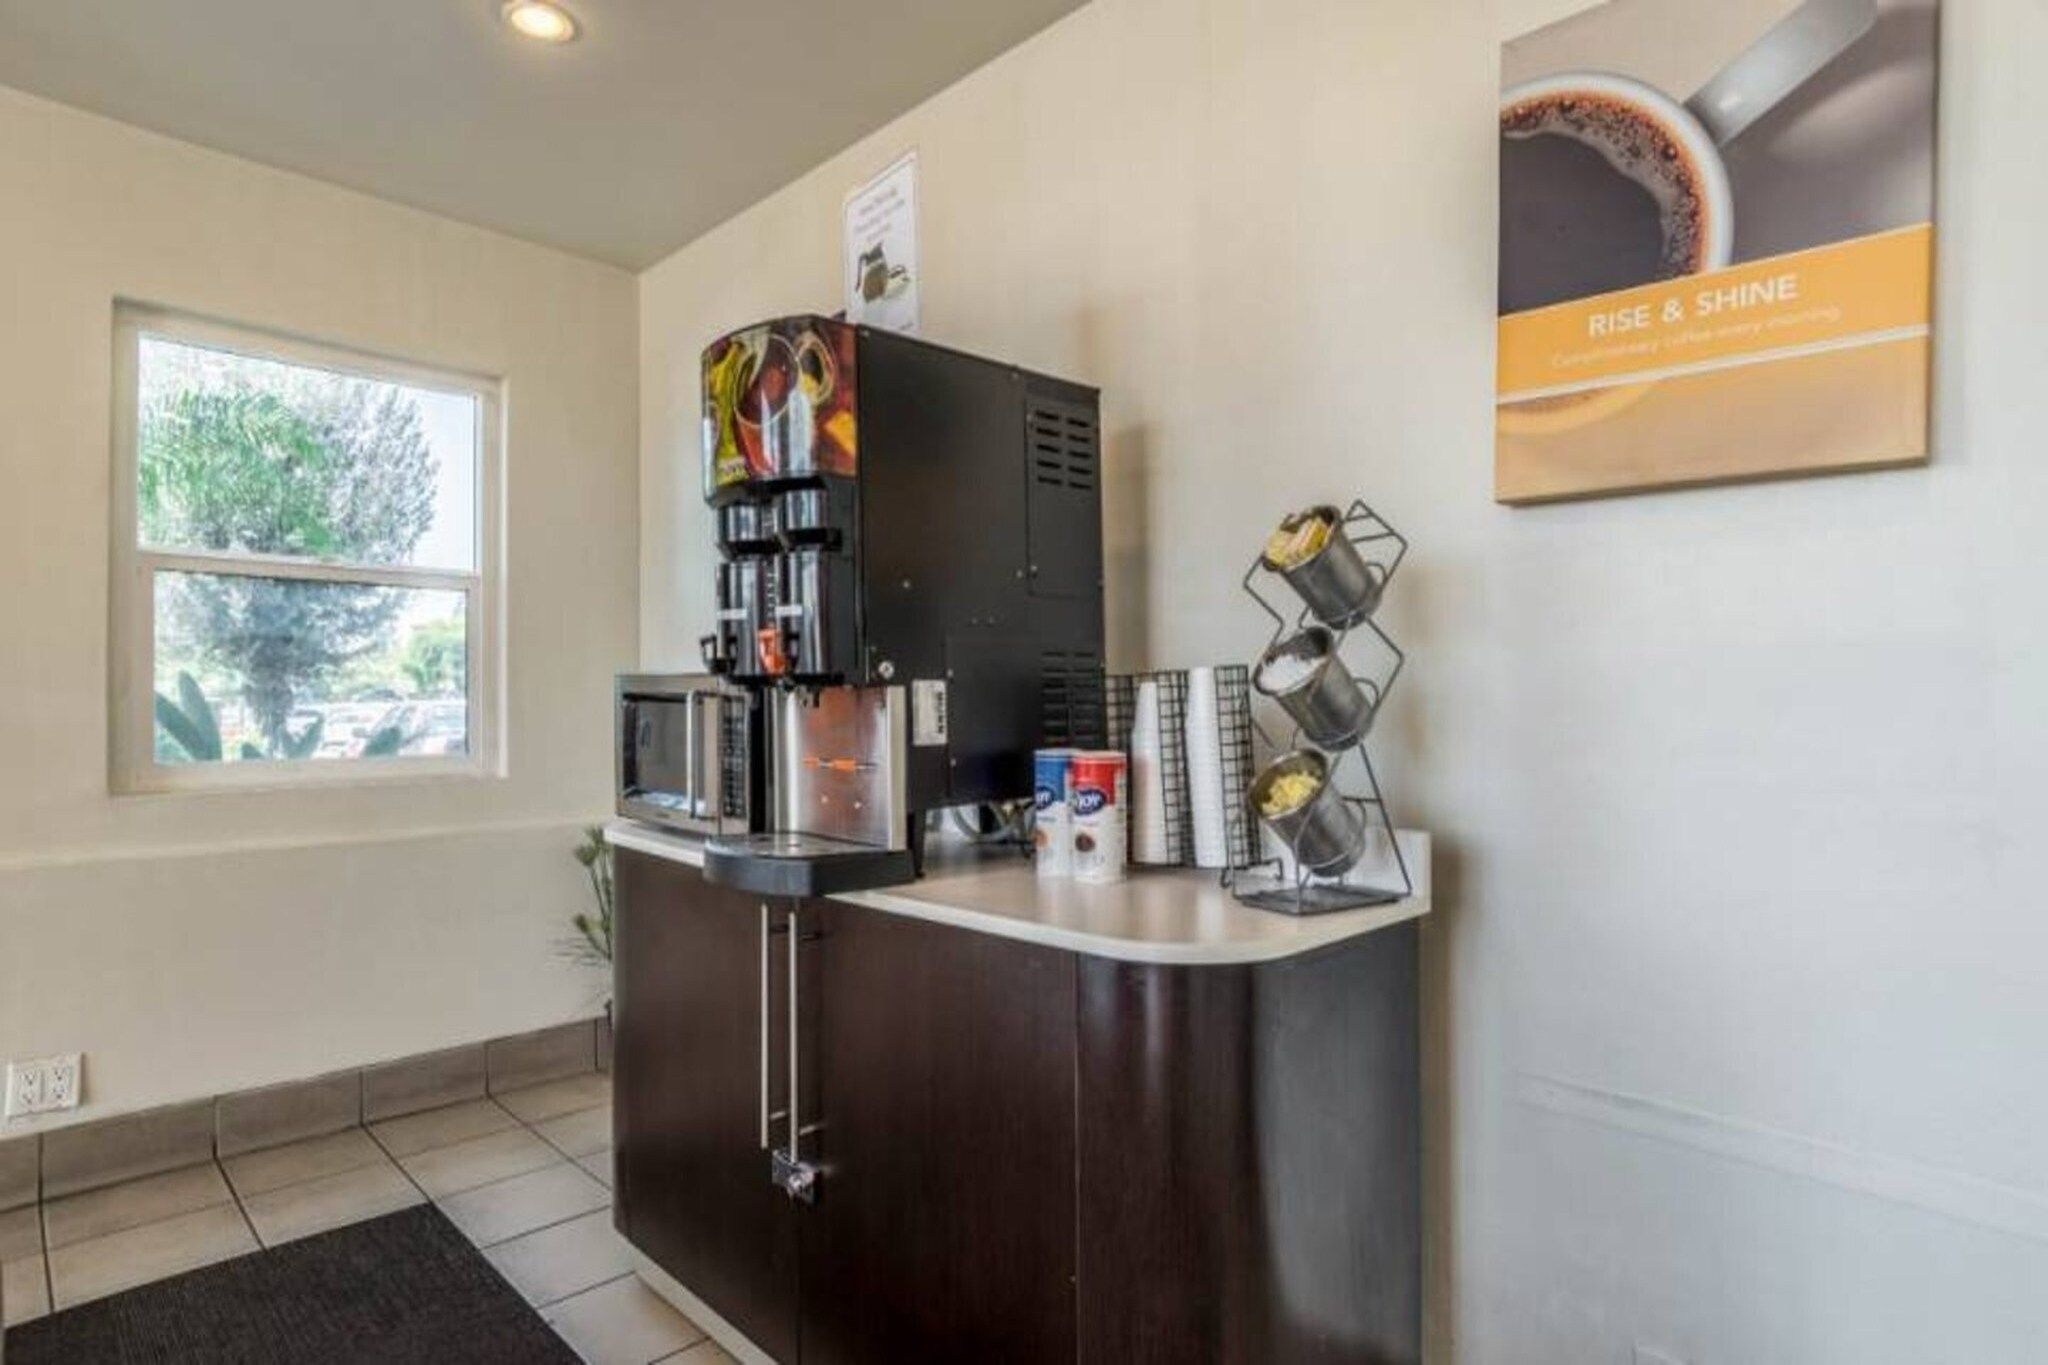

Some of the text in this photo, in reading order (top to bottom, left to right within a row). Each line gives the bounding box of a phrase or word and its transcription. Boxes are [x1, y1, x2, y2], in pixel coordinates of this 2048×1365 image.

[1588, 274, 1797, 337] RISE & SHINE
